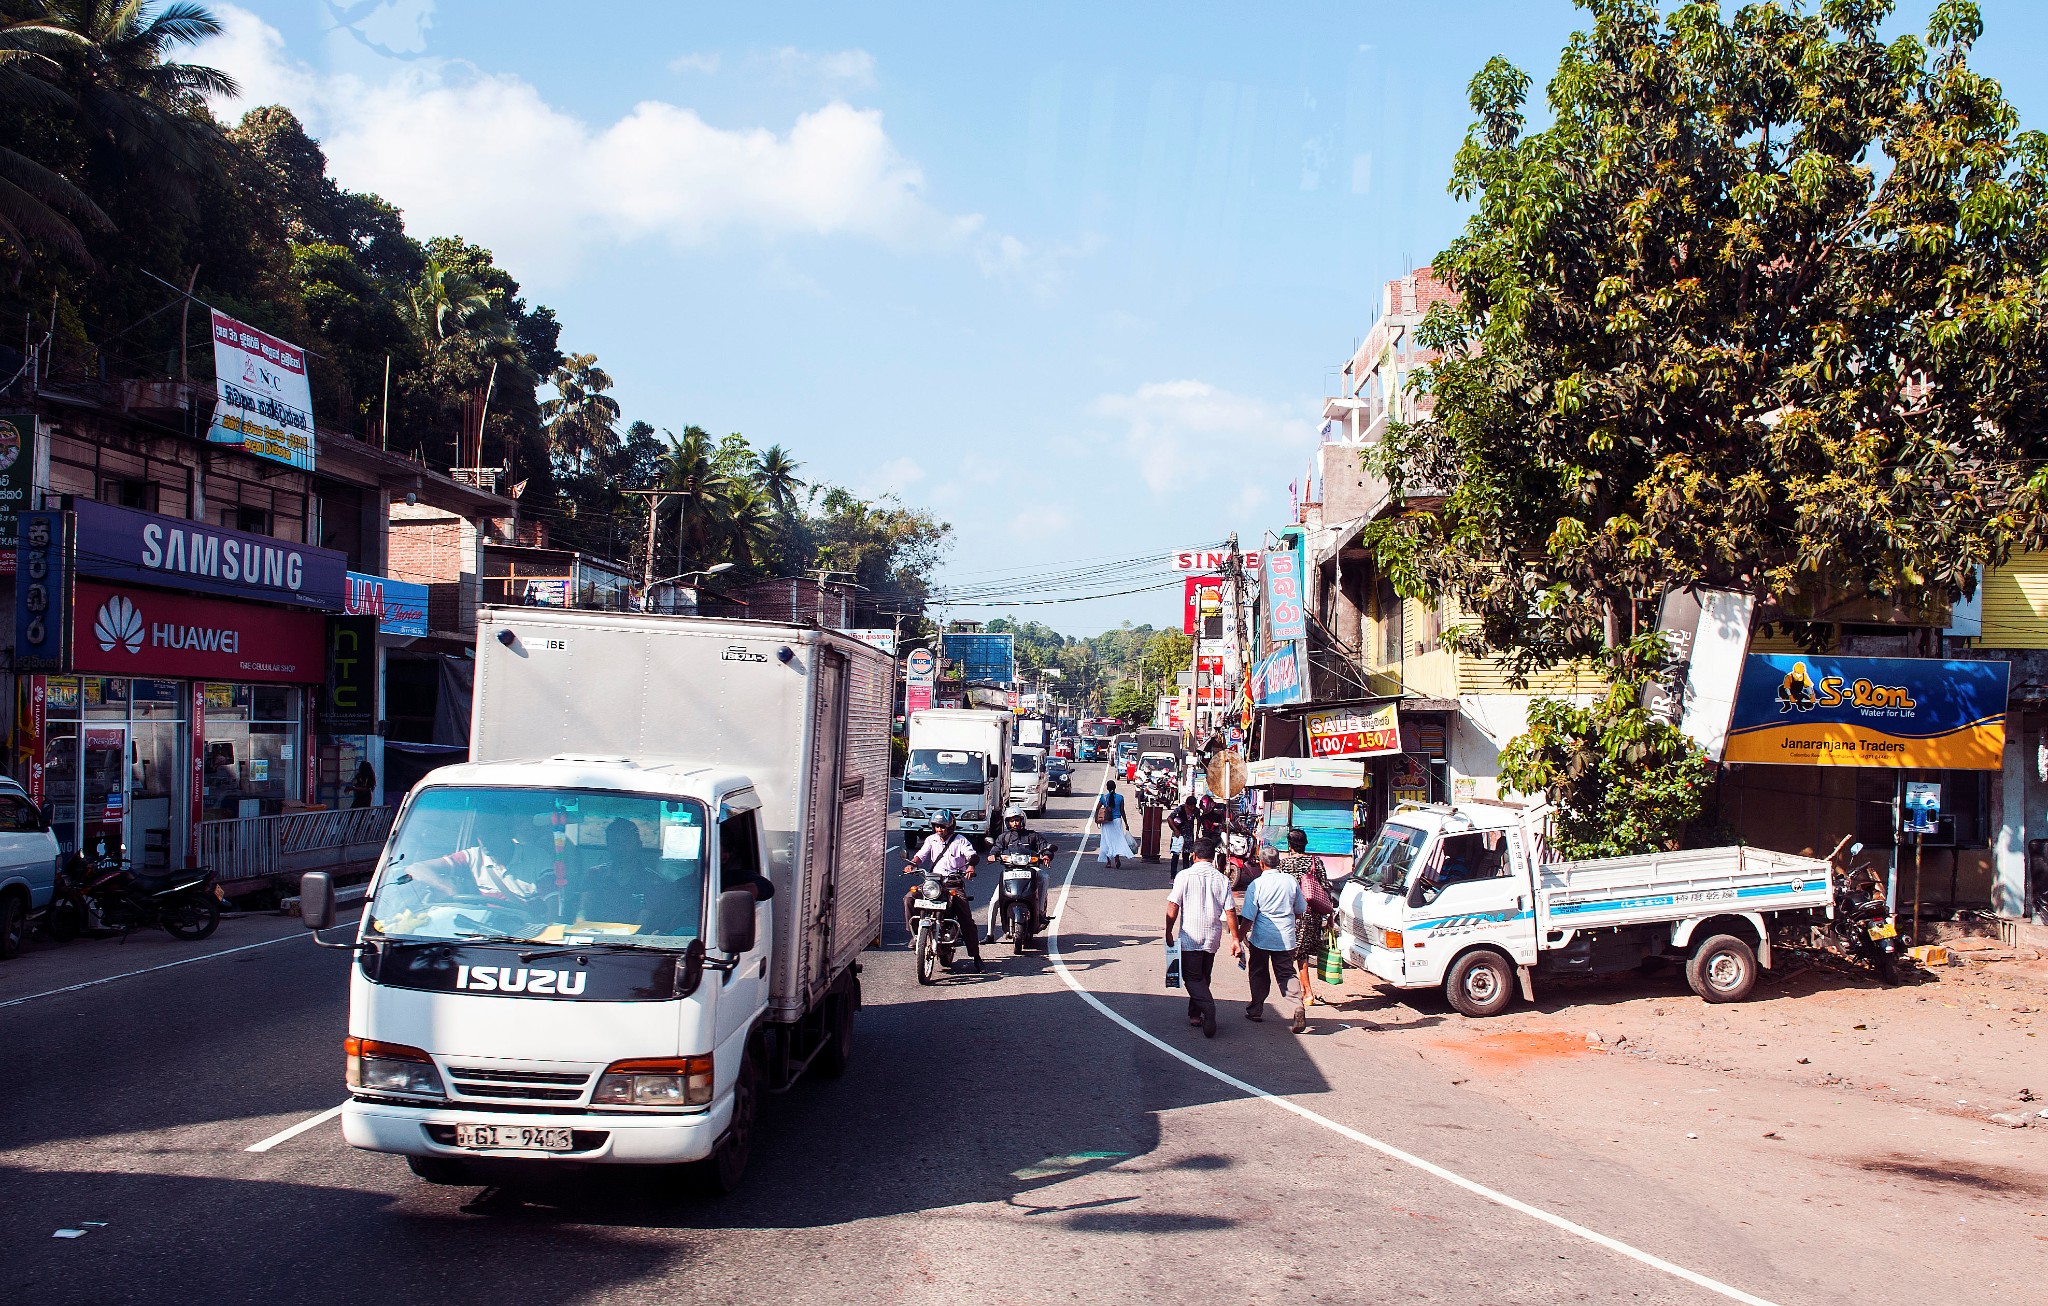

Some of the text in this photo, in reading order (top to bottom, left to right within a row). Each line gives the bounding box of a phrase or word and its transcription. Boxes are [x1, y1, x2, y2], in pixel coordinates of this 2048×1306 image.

[259, 367, 282, 391] NCC
[142, 523, 303, 591] SAMSUNG
[1178, 553, 1259, 569] SINE
[382, 602, 424, 624] Choice
[152, 622, 239, 654] HUAWEI
[239, 661, 296, 673] THE CELLULAR SHOP
[1648, 628, 1685, 728] ORANGE
[1819, 676, 1917, 709] S-lon
[1310, 714, 1358, 734] SALE
[1860, 709, 1885, 717] Water
[1900, 710, 1916, 718] Life
[1313, 731, 1396, 754] 100/- 150/-
[1781, 737, 1905, 752] Janaranjana Traders
[1279, 766, 1303, 778] NLB
[1393, 790, 1427, 804] THE
[456, 965, 587, 995] ISUZU
